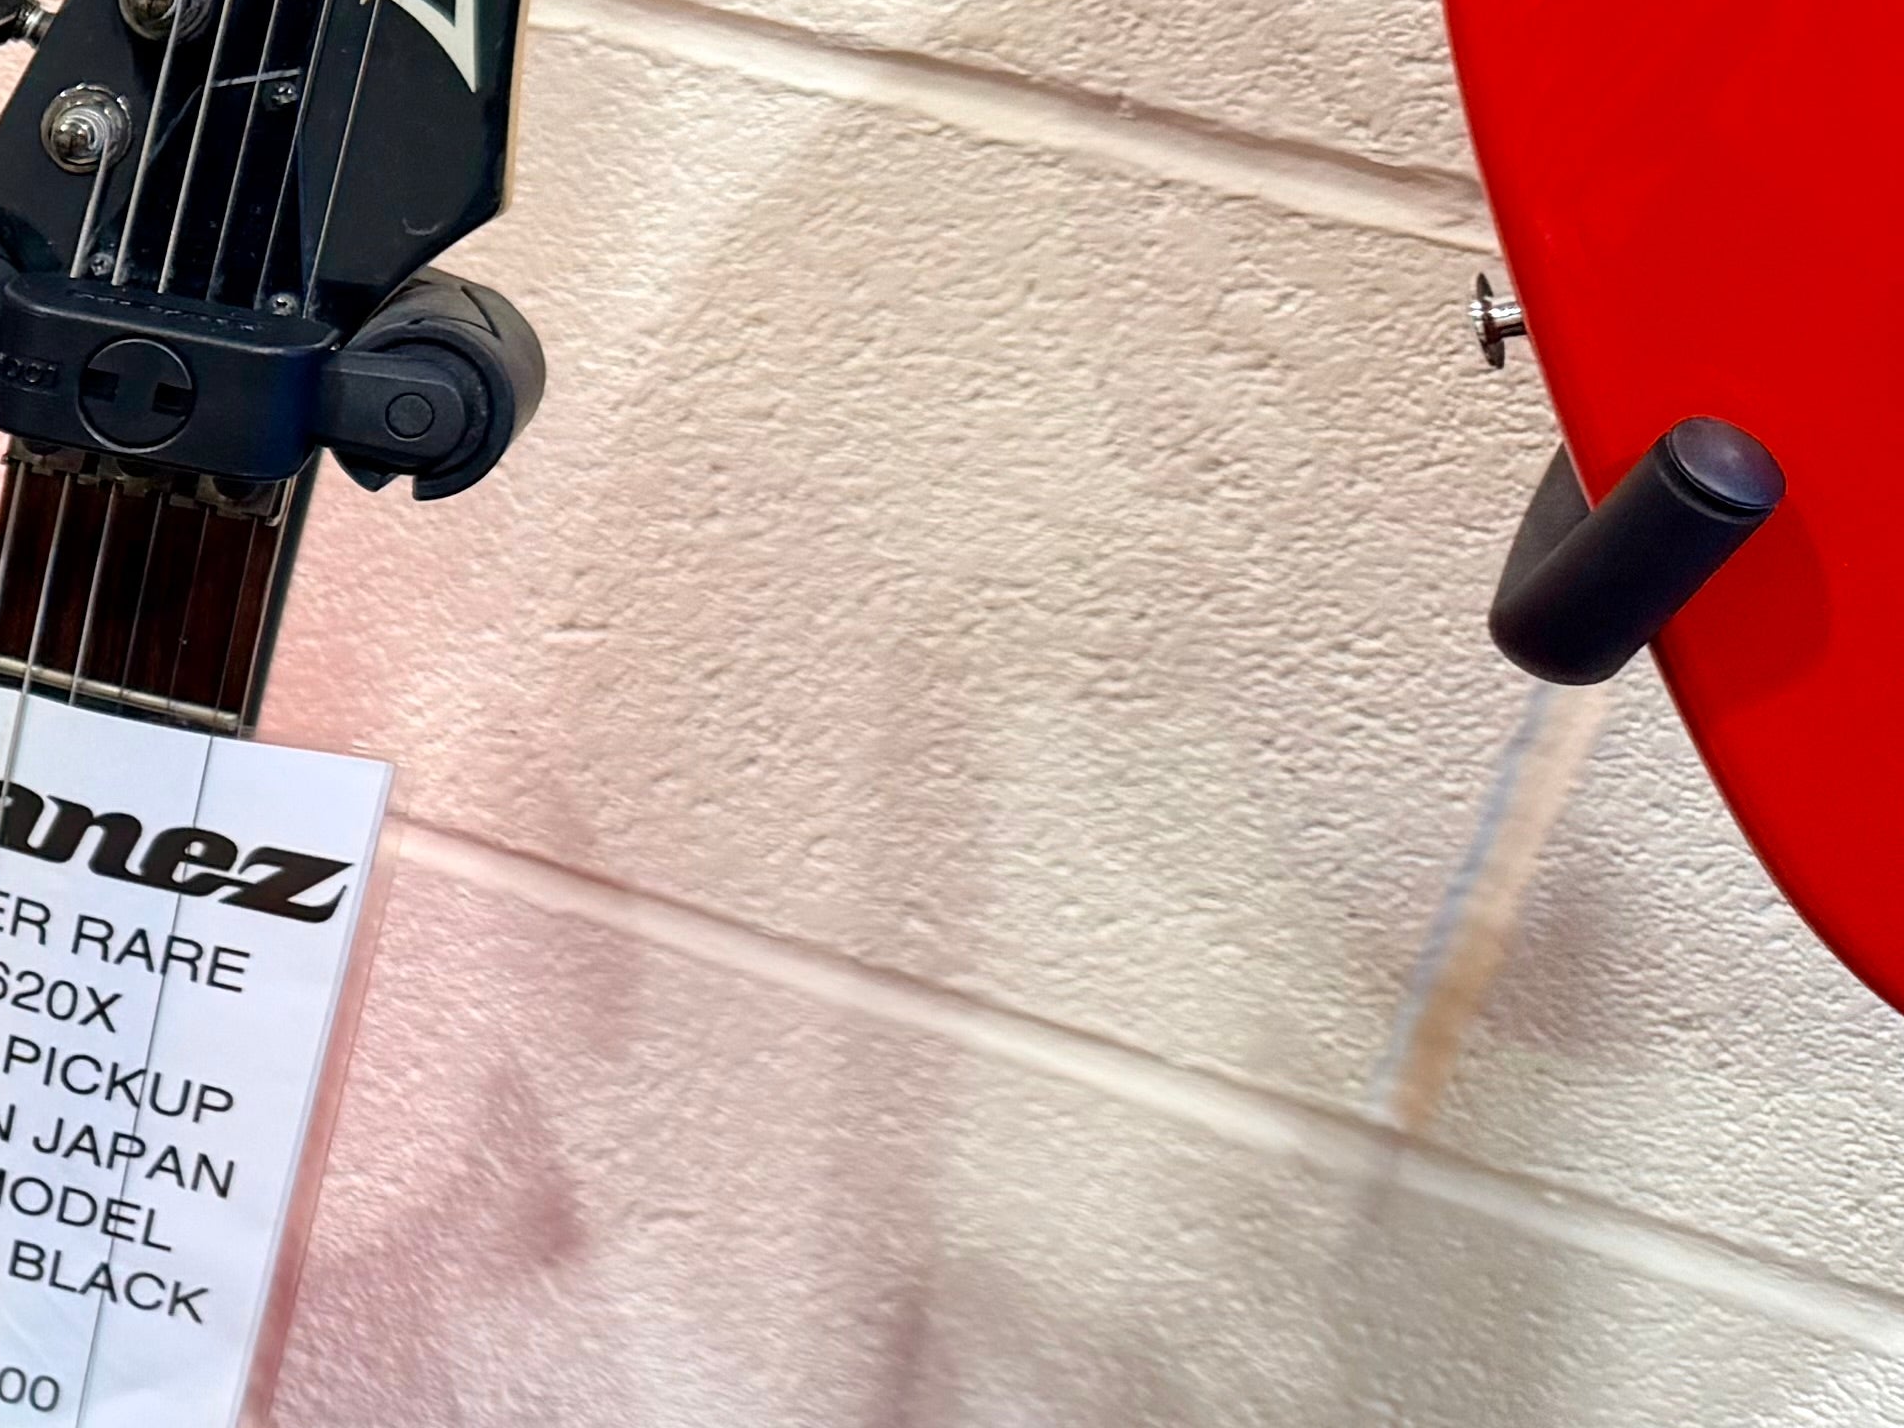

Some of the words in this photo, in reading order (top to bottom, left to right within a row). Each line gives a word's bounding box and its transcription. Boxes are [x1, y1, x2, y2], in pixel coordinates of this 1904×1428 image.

[71, 914, 251, 994] RARE
[3, 1035, 234, 1123] PICKUP
[33, 1116, 236, 1200] JAPAN
[8, 1238, 210, 1325] BLACK
